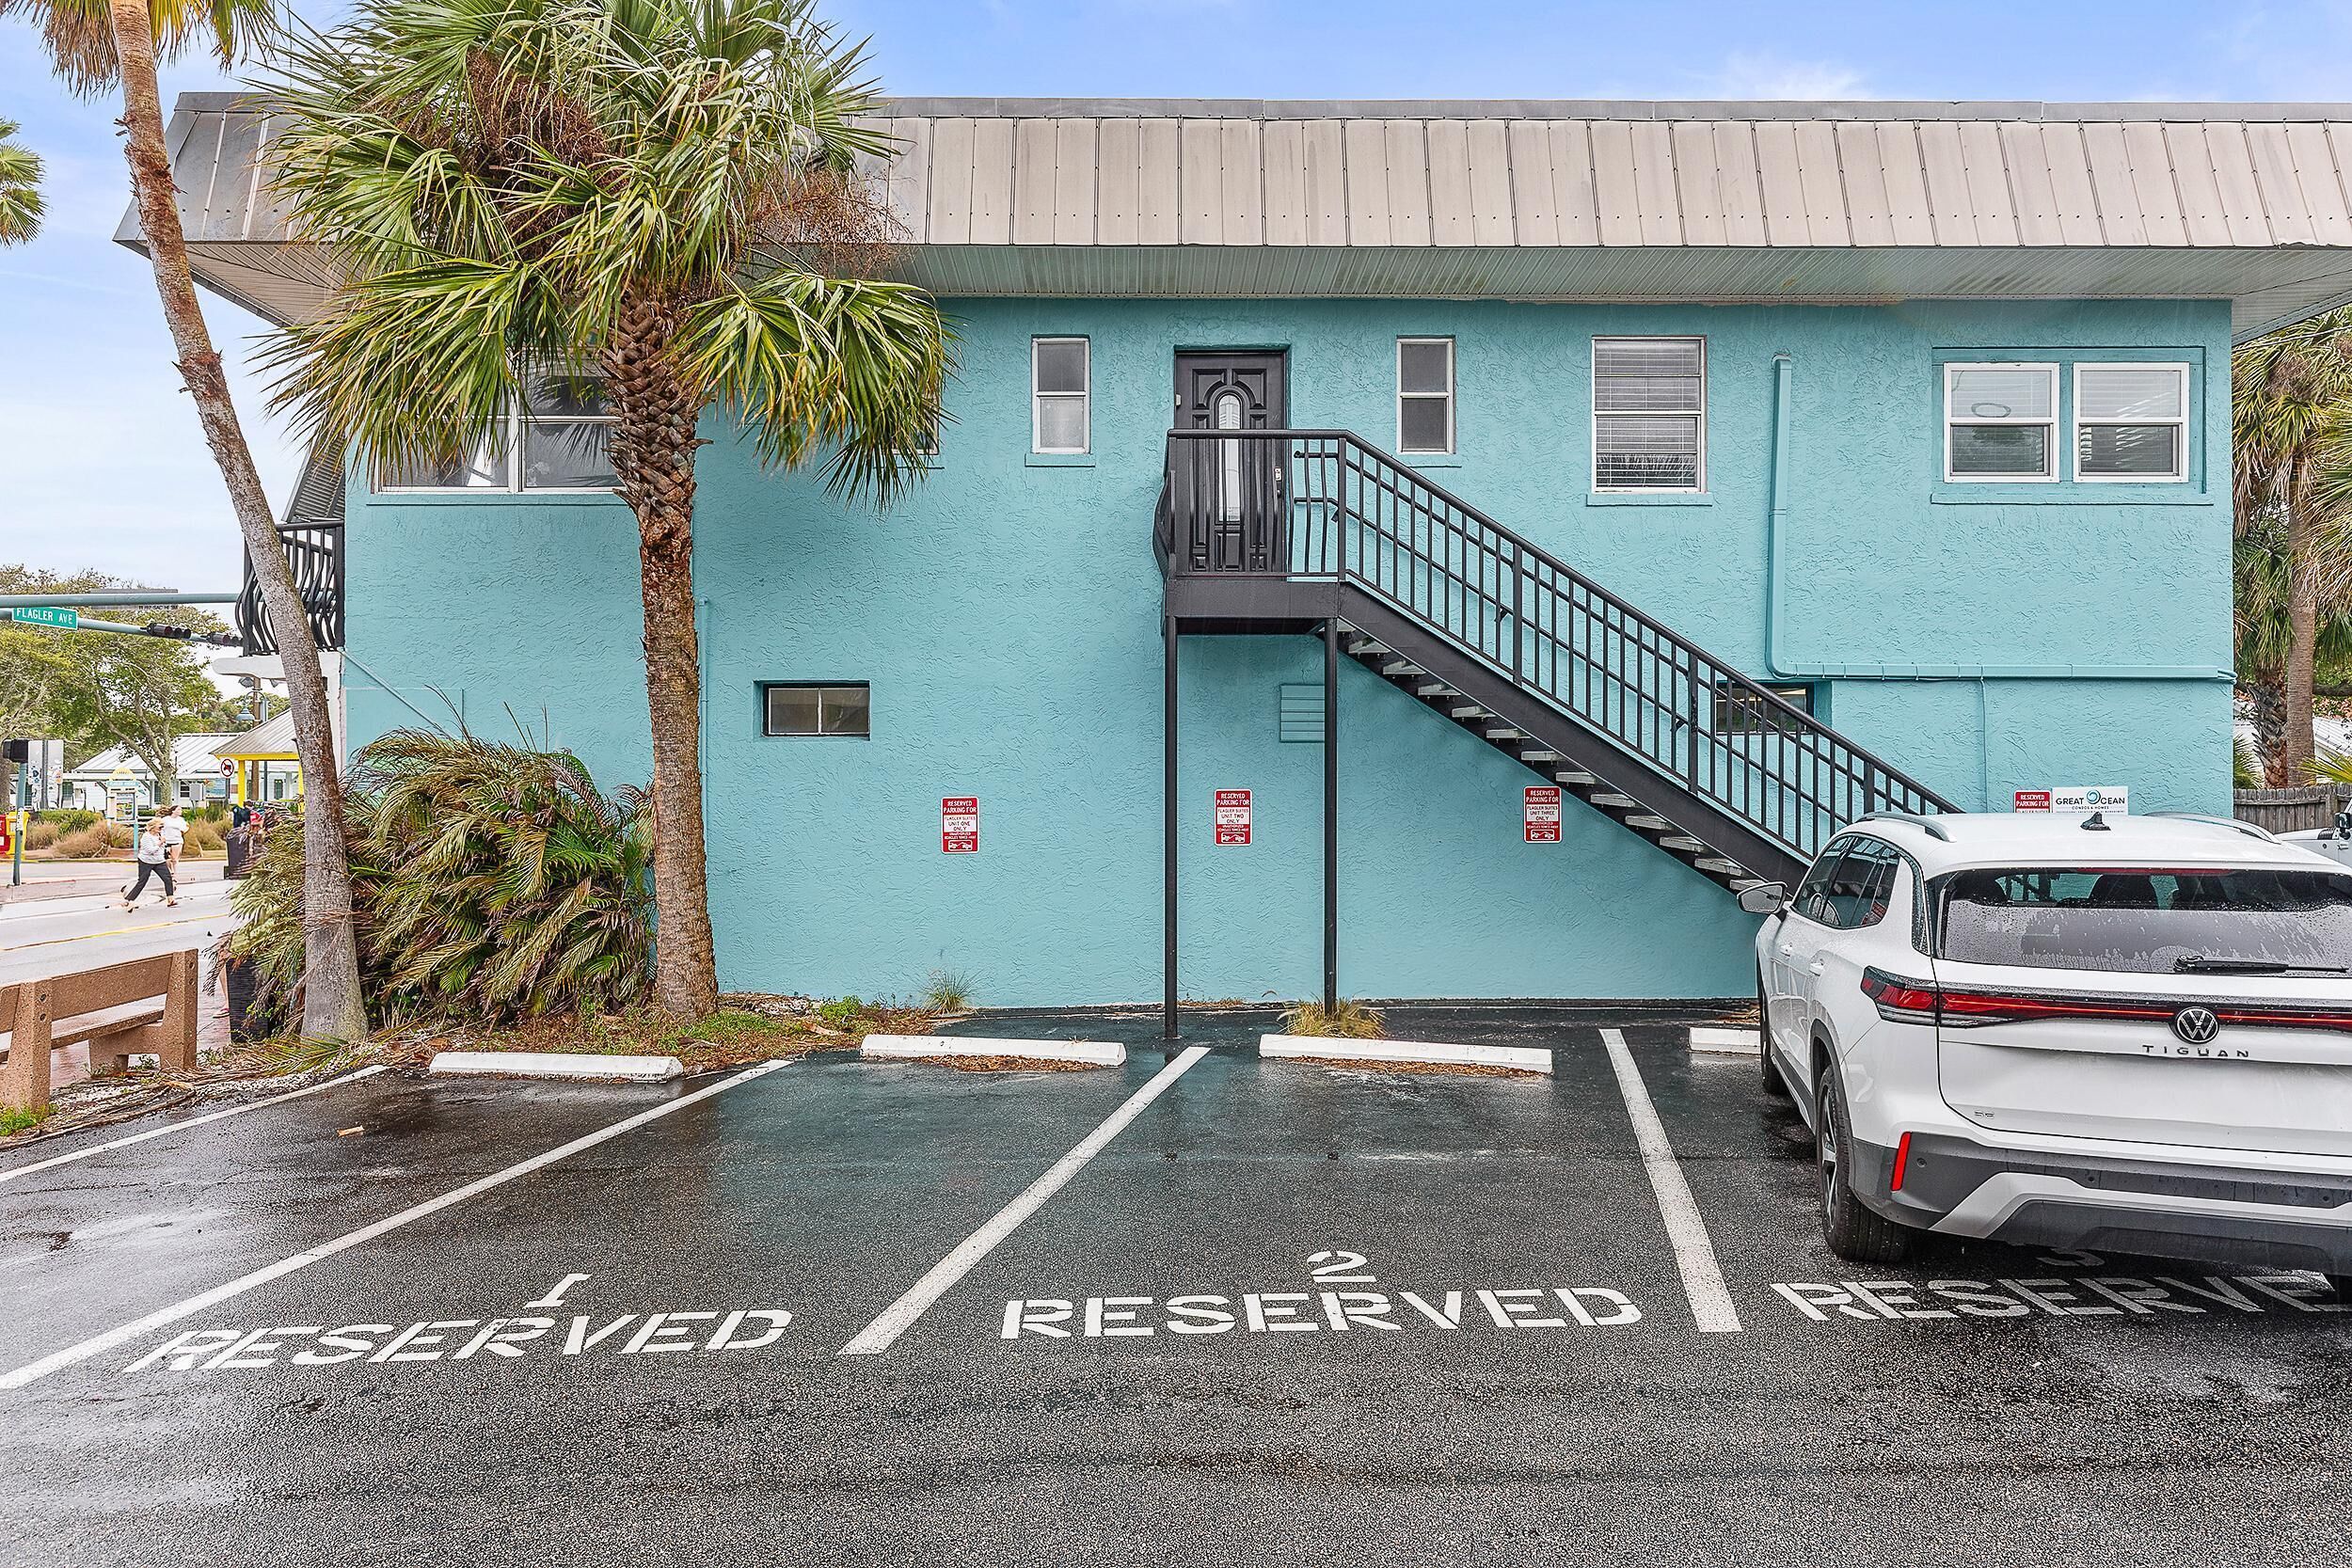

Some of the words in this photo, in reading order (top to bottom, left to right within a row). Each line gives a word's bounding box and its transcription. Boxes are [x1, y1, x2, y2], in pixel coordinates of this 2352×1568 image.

[16, 608, 54, 622] FLAGLER
[58, 612, 72, 625] AVE
[2142, 1045, 2249, 1057] TIGUAN
[1306, 1250, 1376, 1283] 2
[1001, 1287, 1644, 1340] RESERVED
[1769, 1275, 2352, 1322] RESERVE
[122, 1309, 792, 1373] RESERVED
